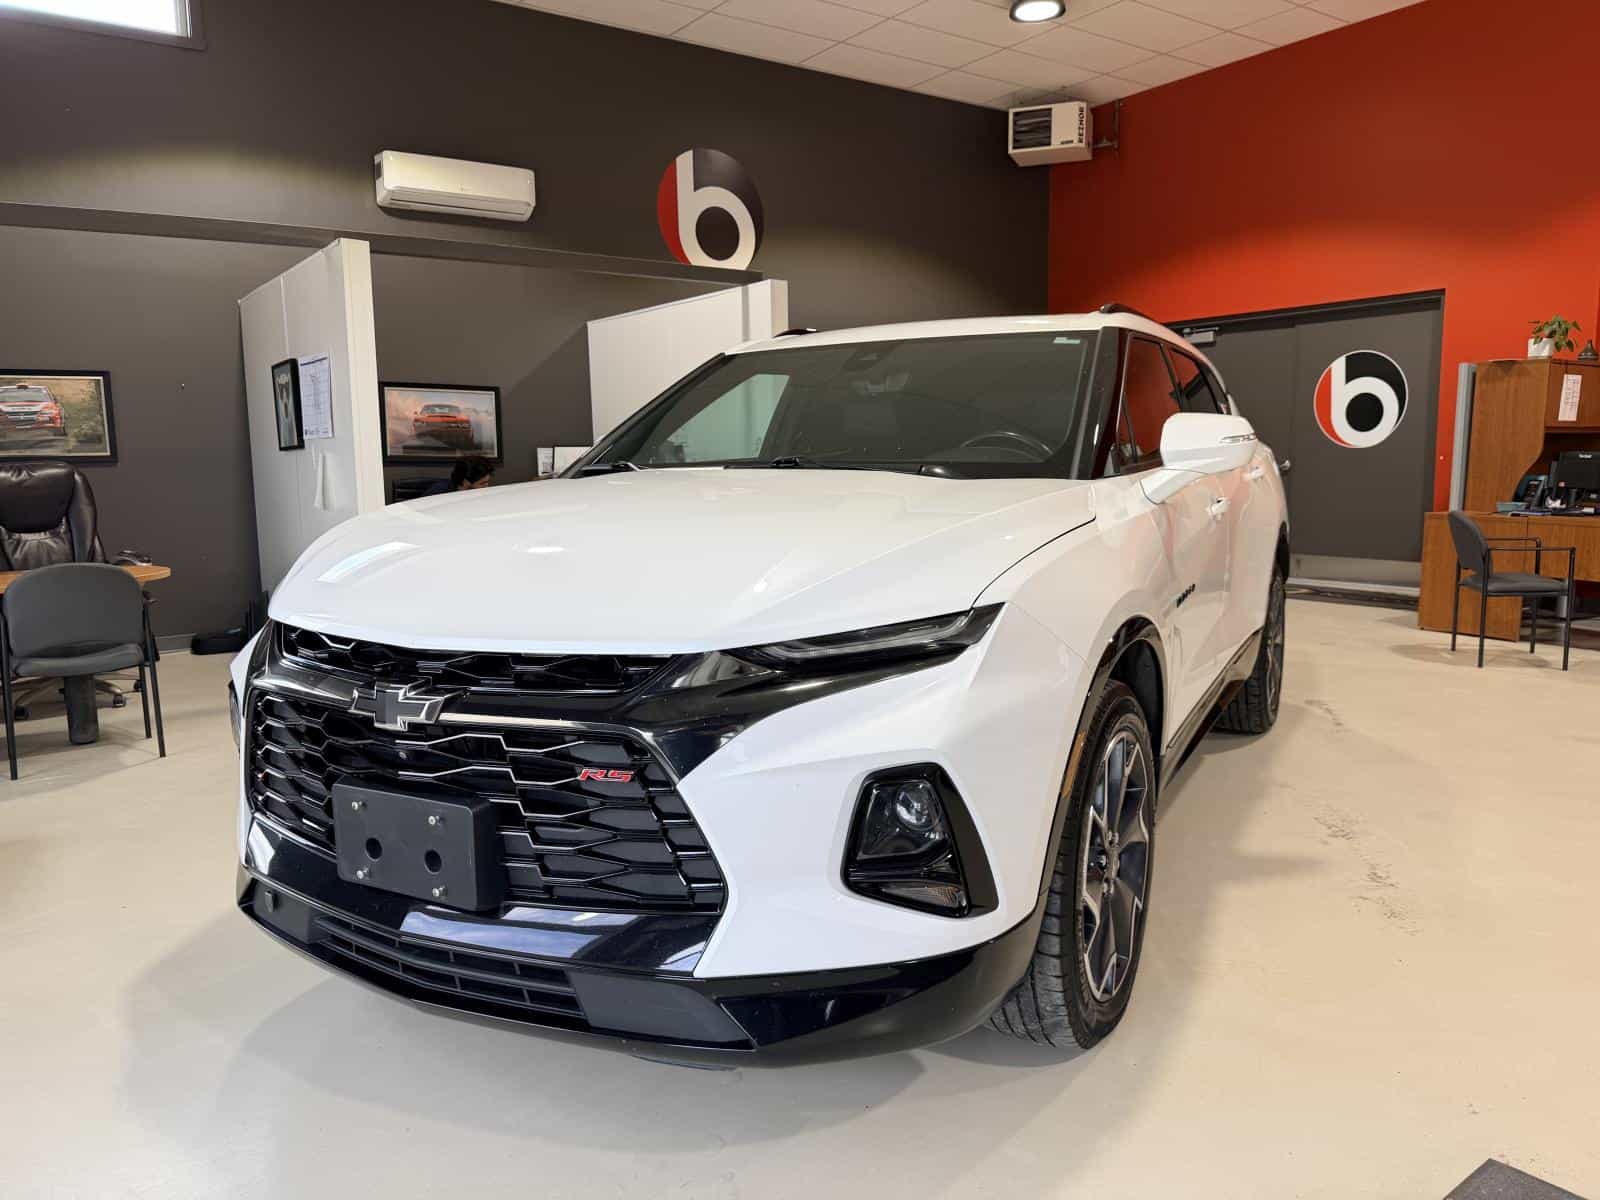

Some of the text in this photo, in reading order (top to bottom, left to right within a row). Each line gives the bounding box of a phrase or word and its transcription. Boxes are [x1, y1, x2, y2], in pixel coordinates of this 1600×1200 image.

[675, 149, 756, 270] b
[1329, 354, 1400, 448] b
[579, 768, 634, 783] RS
